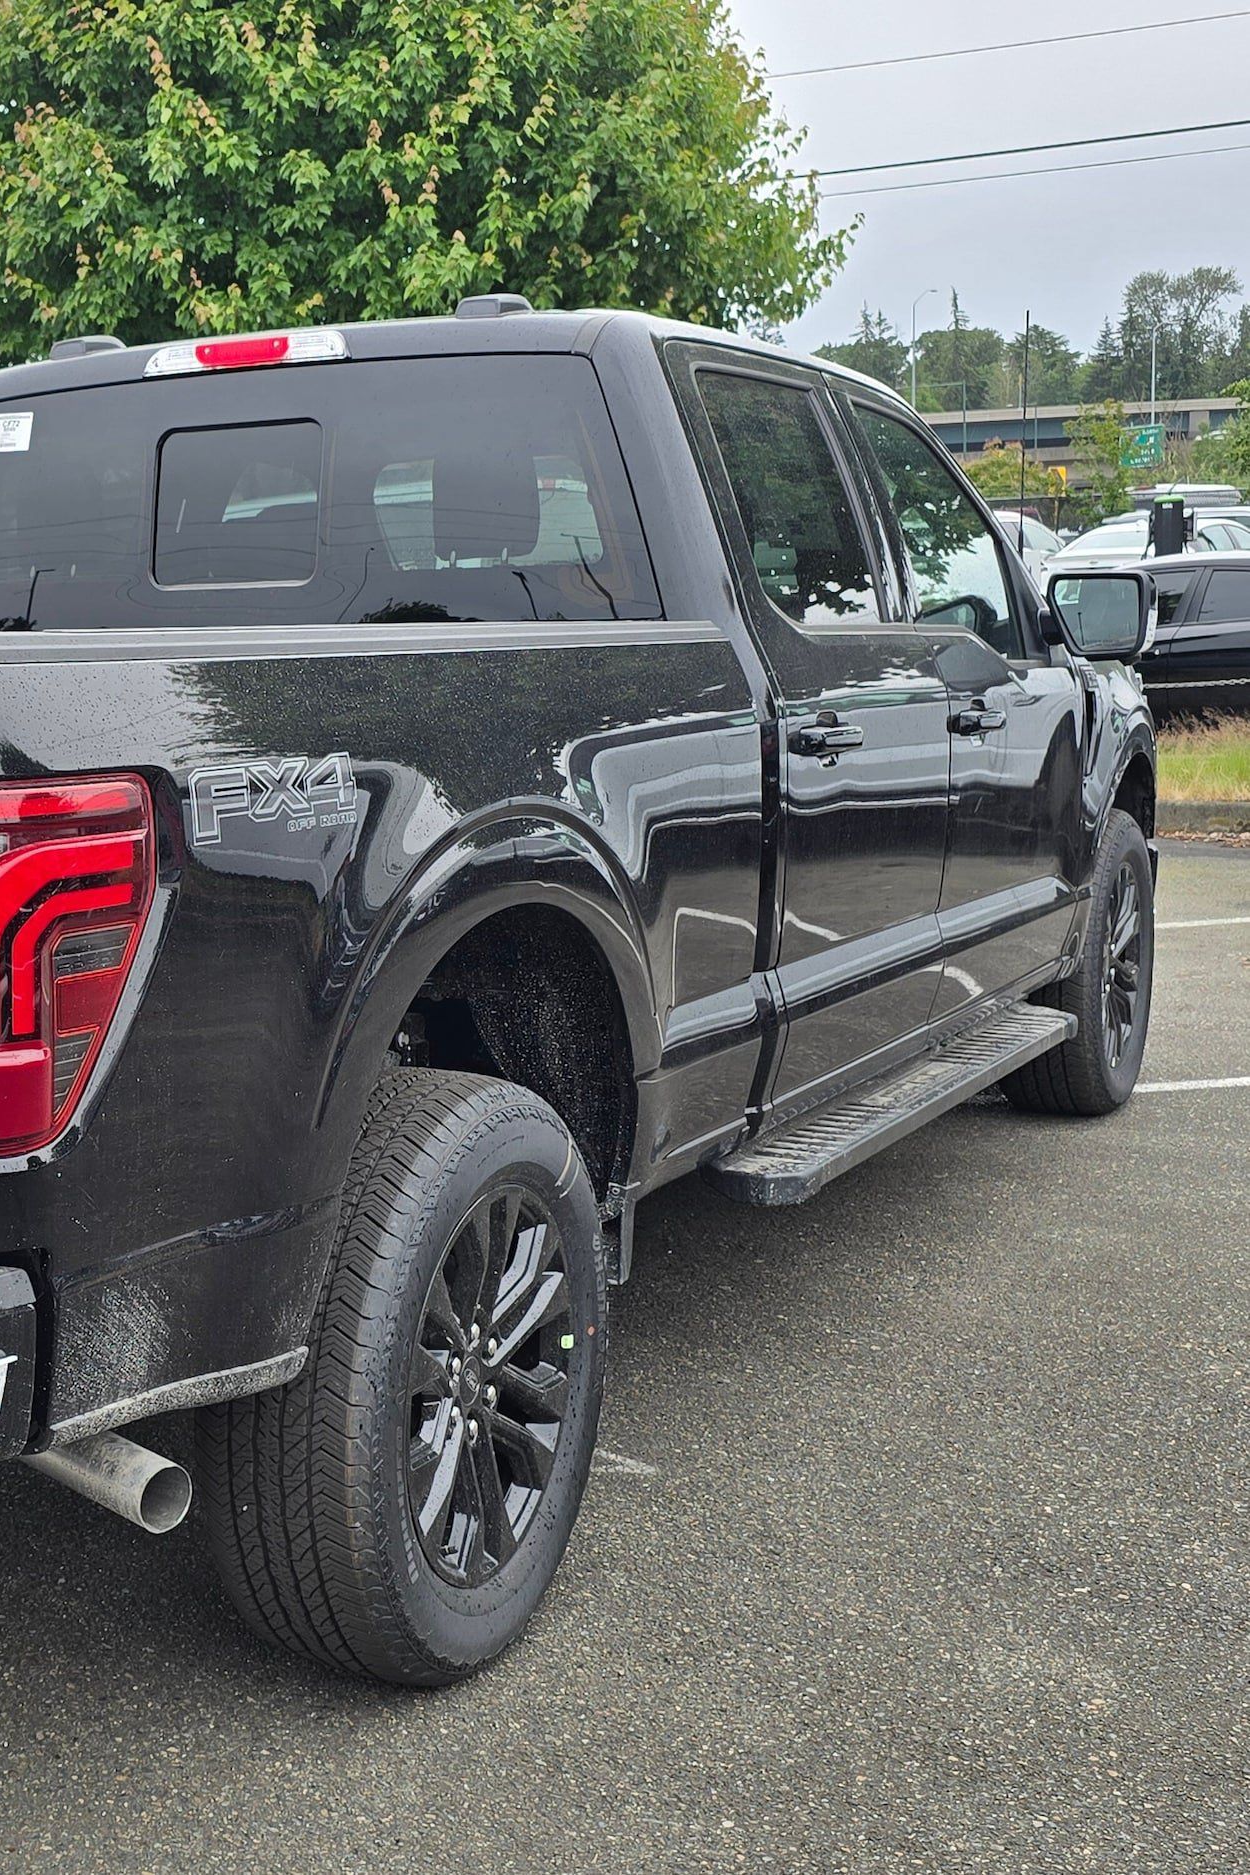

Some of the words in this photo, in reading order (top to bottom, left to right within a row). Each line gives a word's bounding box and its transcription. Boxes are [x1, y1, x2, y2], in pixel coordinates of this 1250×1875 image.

[188, 751, 358, 846] FX4
[287, 817, 316, 833] OFF
[320, 811, 357, 828] ROAD
